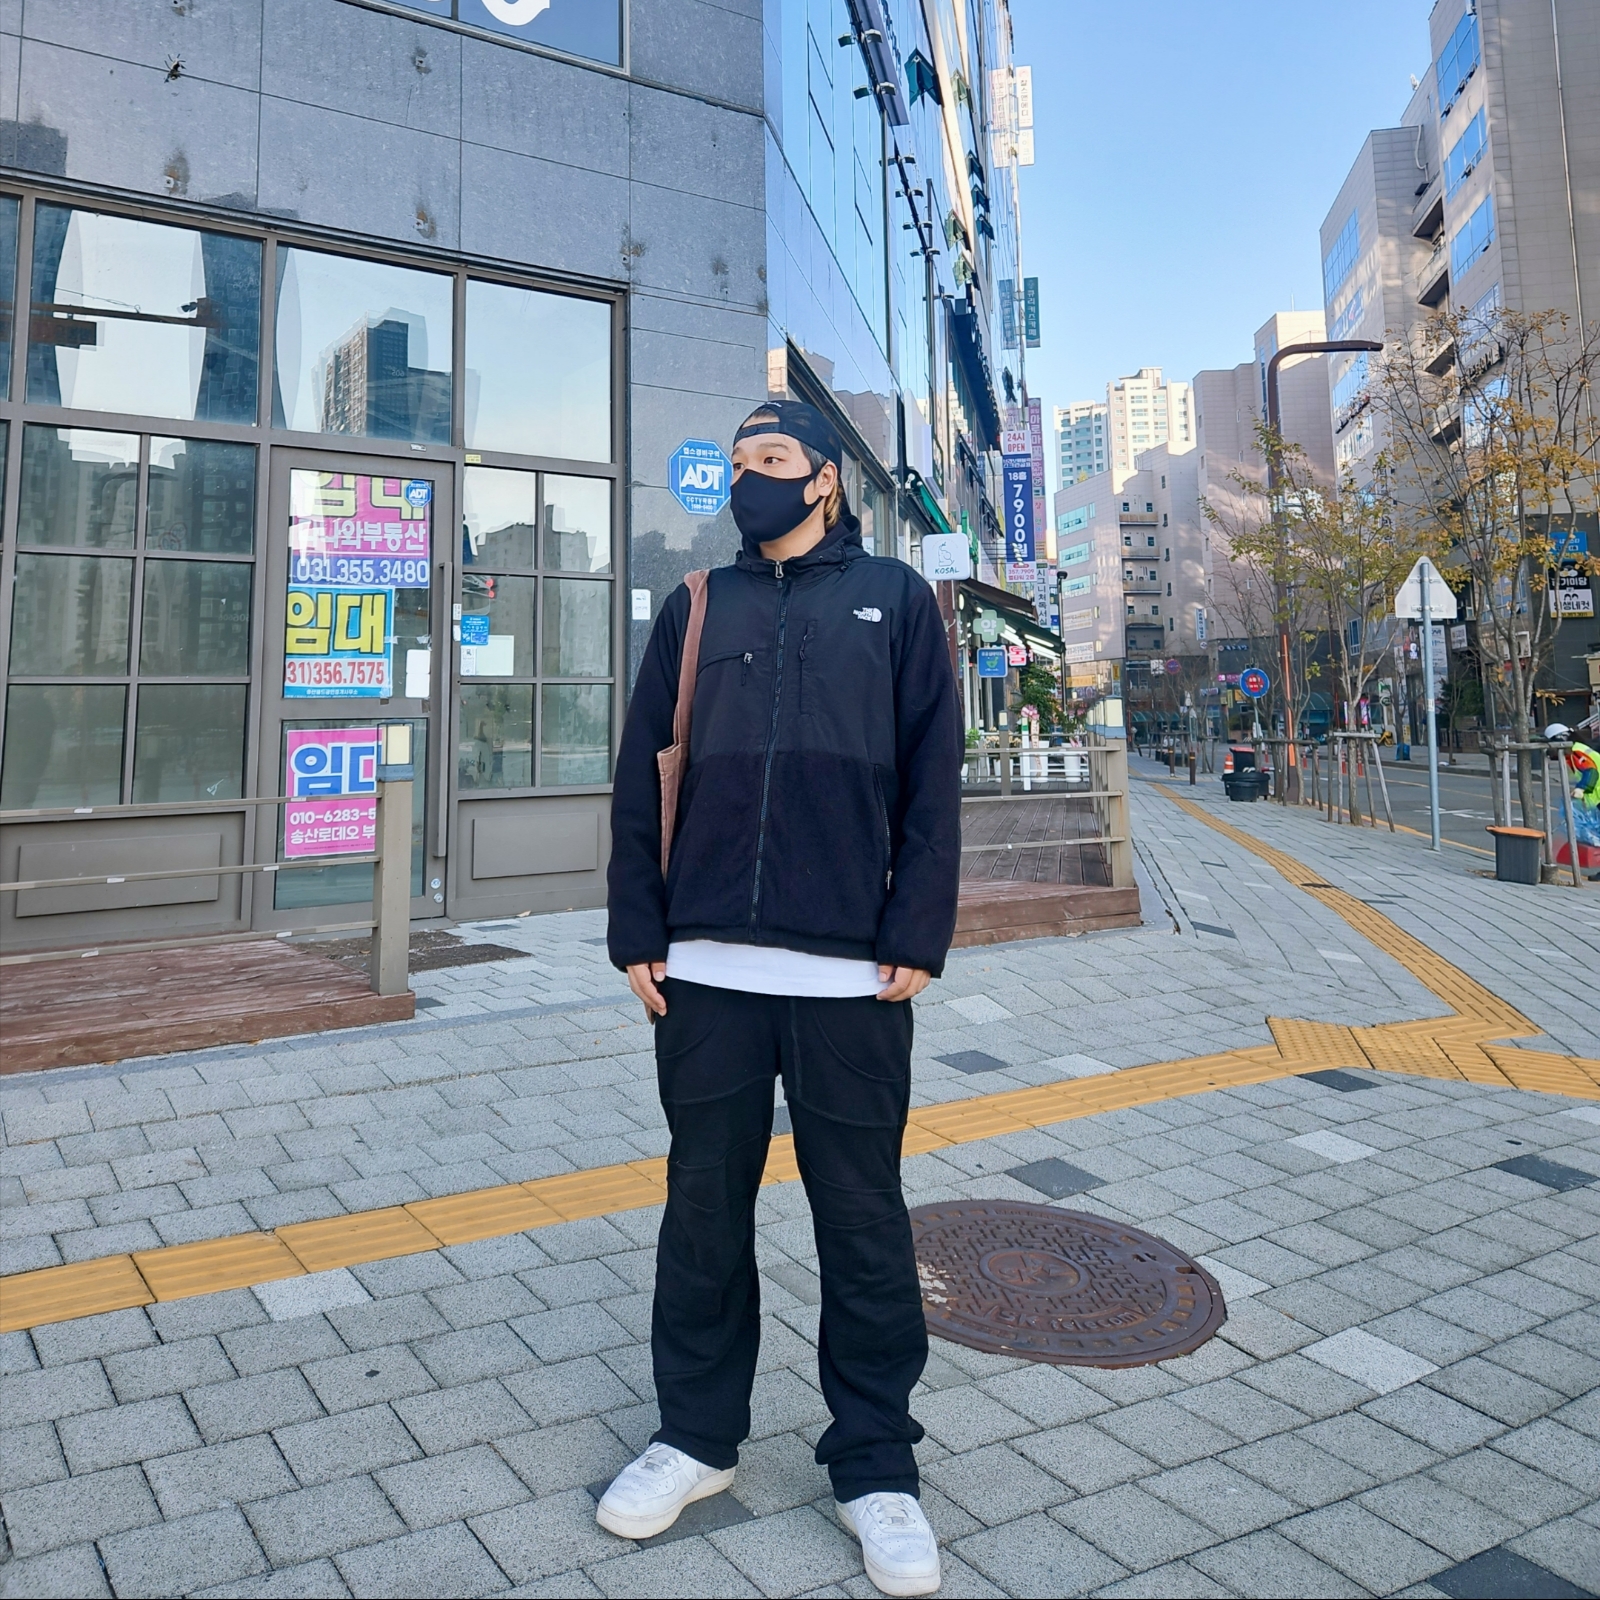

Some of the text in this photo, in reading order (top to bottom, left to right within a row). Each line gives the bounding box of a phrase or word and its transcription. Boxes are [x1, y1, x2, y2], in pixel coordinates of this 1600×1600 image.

[1007, 432, 1025, 442] 24시
[1007, 443, 1025, 452] OPEN
[681, 463, 723, 490] ADT
[408, 488, 428, 499] ADT
[296, 558, 428, 584] 031.355.3480
[935, 567, 959, 575] KOSAL
[286, 591, 387, 655] 임대
[981, 620, 996, 636] 약
[285, 661, 385, 685] 31)356.7575
[290, 826, 360, 845] 송산로데오
[999, 1309, 1139, 1331] SK telecom
